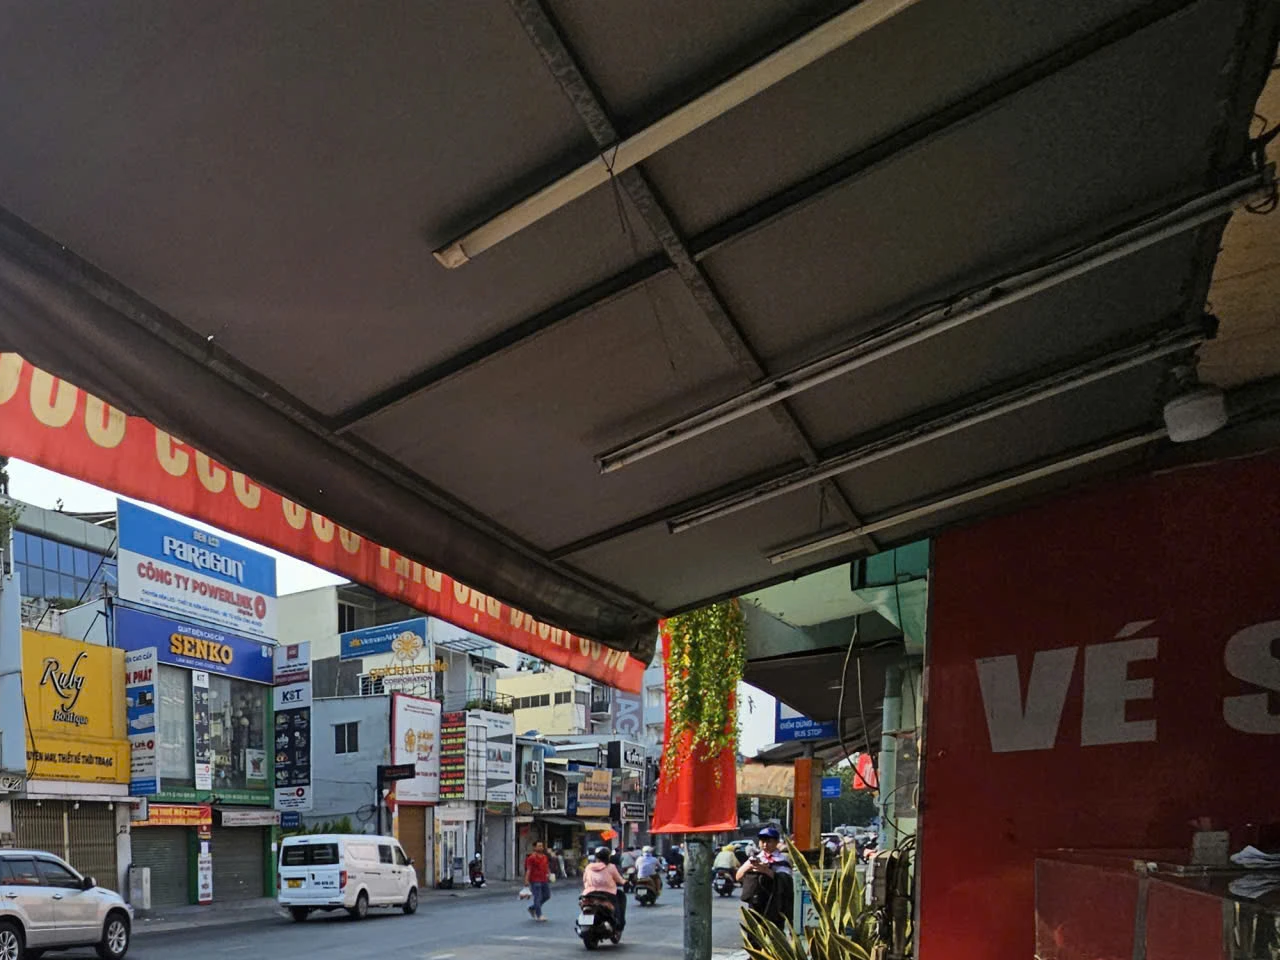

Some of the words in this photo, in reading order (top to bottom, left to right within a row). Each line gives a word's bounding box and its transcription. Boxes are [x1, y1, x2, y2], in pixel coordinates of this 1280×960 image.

[137, 561, 172, 586] CÔNG
[174, 573, 189, 591] TY
[192, 579, 253, 611] POWERLINK
[169, 633, 234, 665] SENKO
[40, 651, 88, 712] Ruby
[133, 667, 152, 684] PHÁT
[975, 618, 1159, 753] VÉ
[807, 728, 823, 737] STOP
